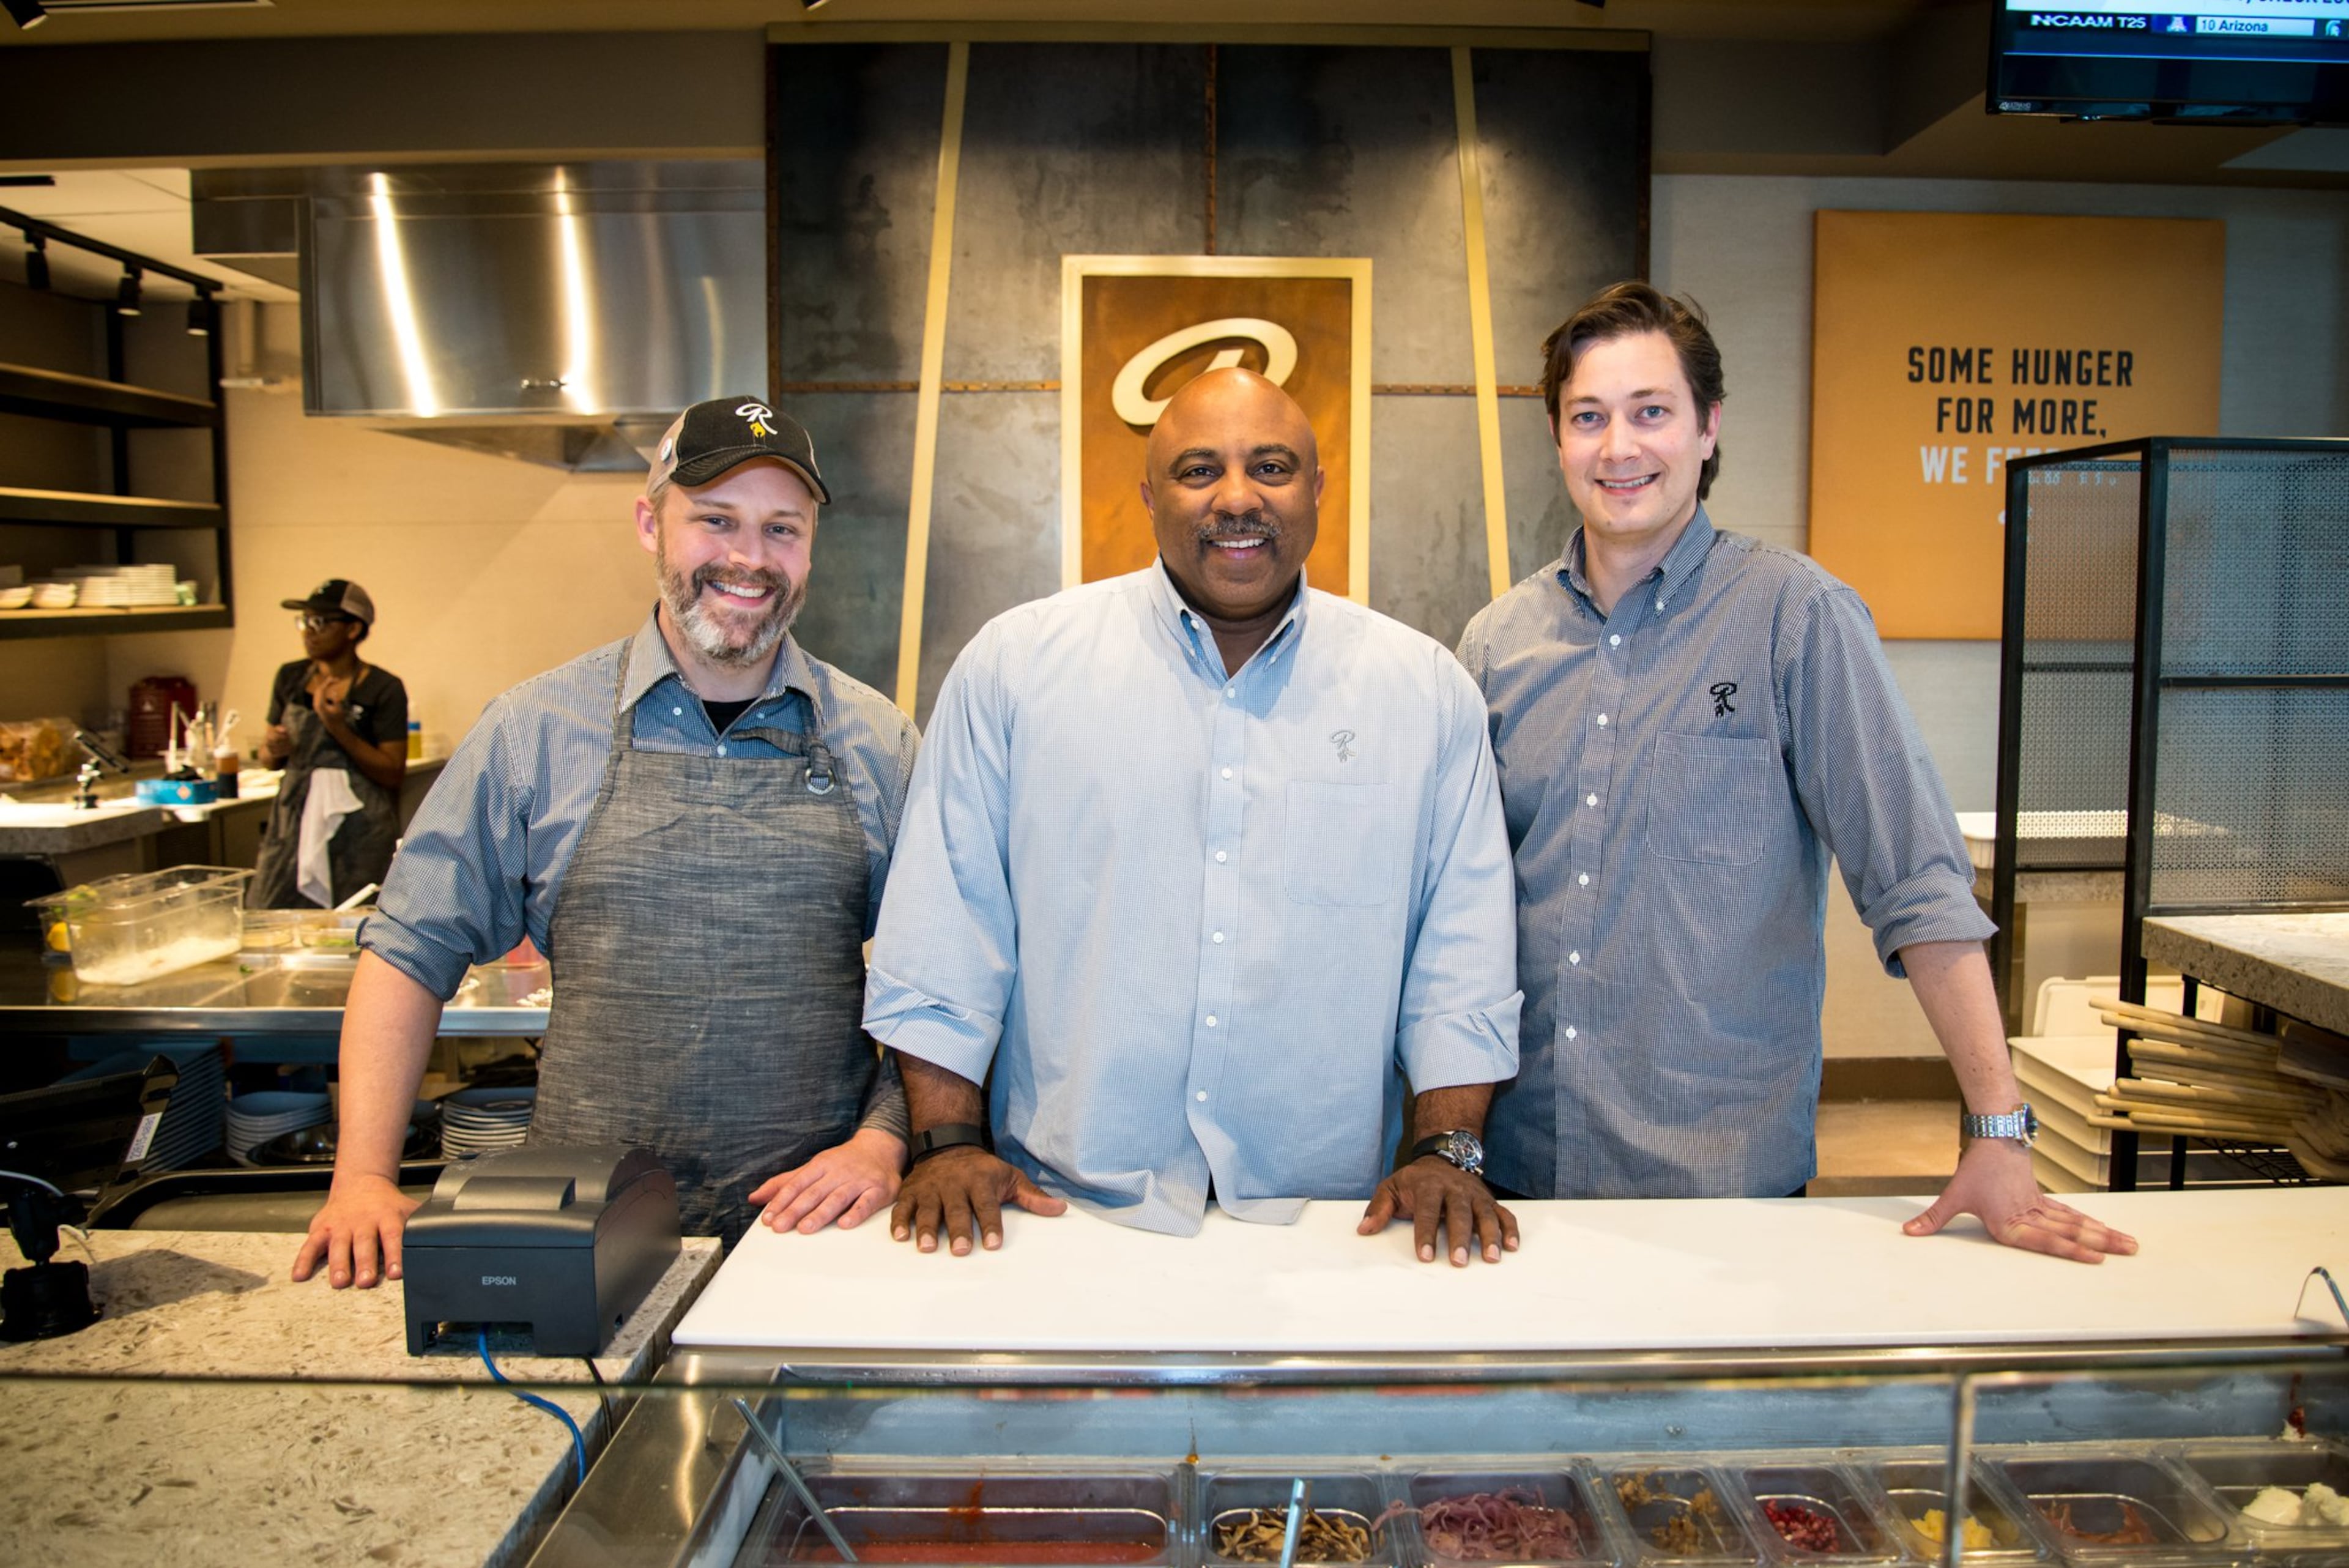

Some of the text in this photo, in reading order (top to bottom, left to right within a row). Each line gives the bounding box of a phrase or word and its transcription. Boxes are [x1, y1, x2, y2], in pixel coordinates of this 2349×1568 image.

[2030, 14, 2147, 28] NCAAM T25
[2202, 19, 2268, 32] 10 Arizona
[1908, 346, 2134, 387] SOME HUNGER
[1937, 397, 2106, 438] FOR MORE,
[1920, 446, 1969, 484] WE
[482, 1276, 516, 1285] EPSON
